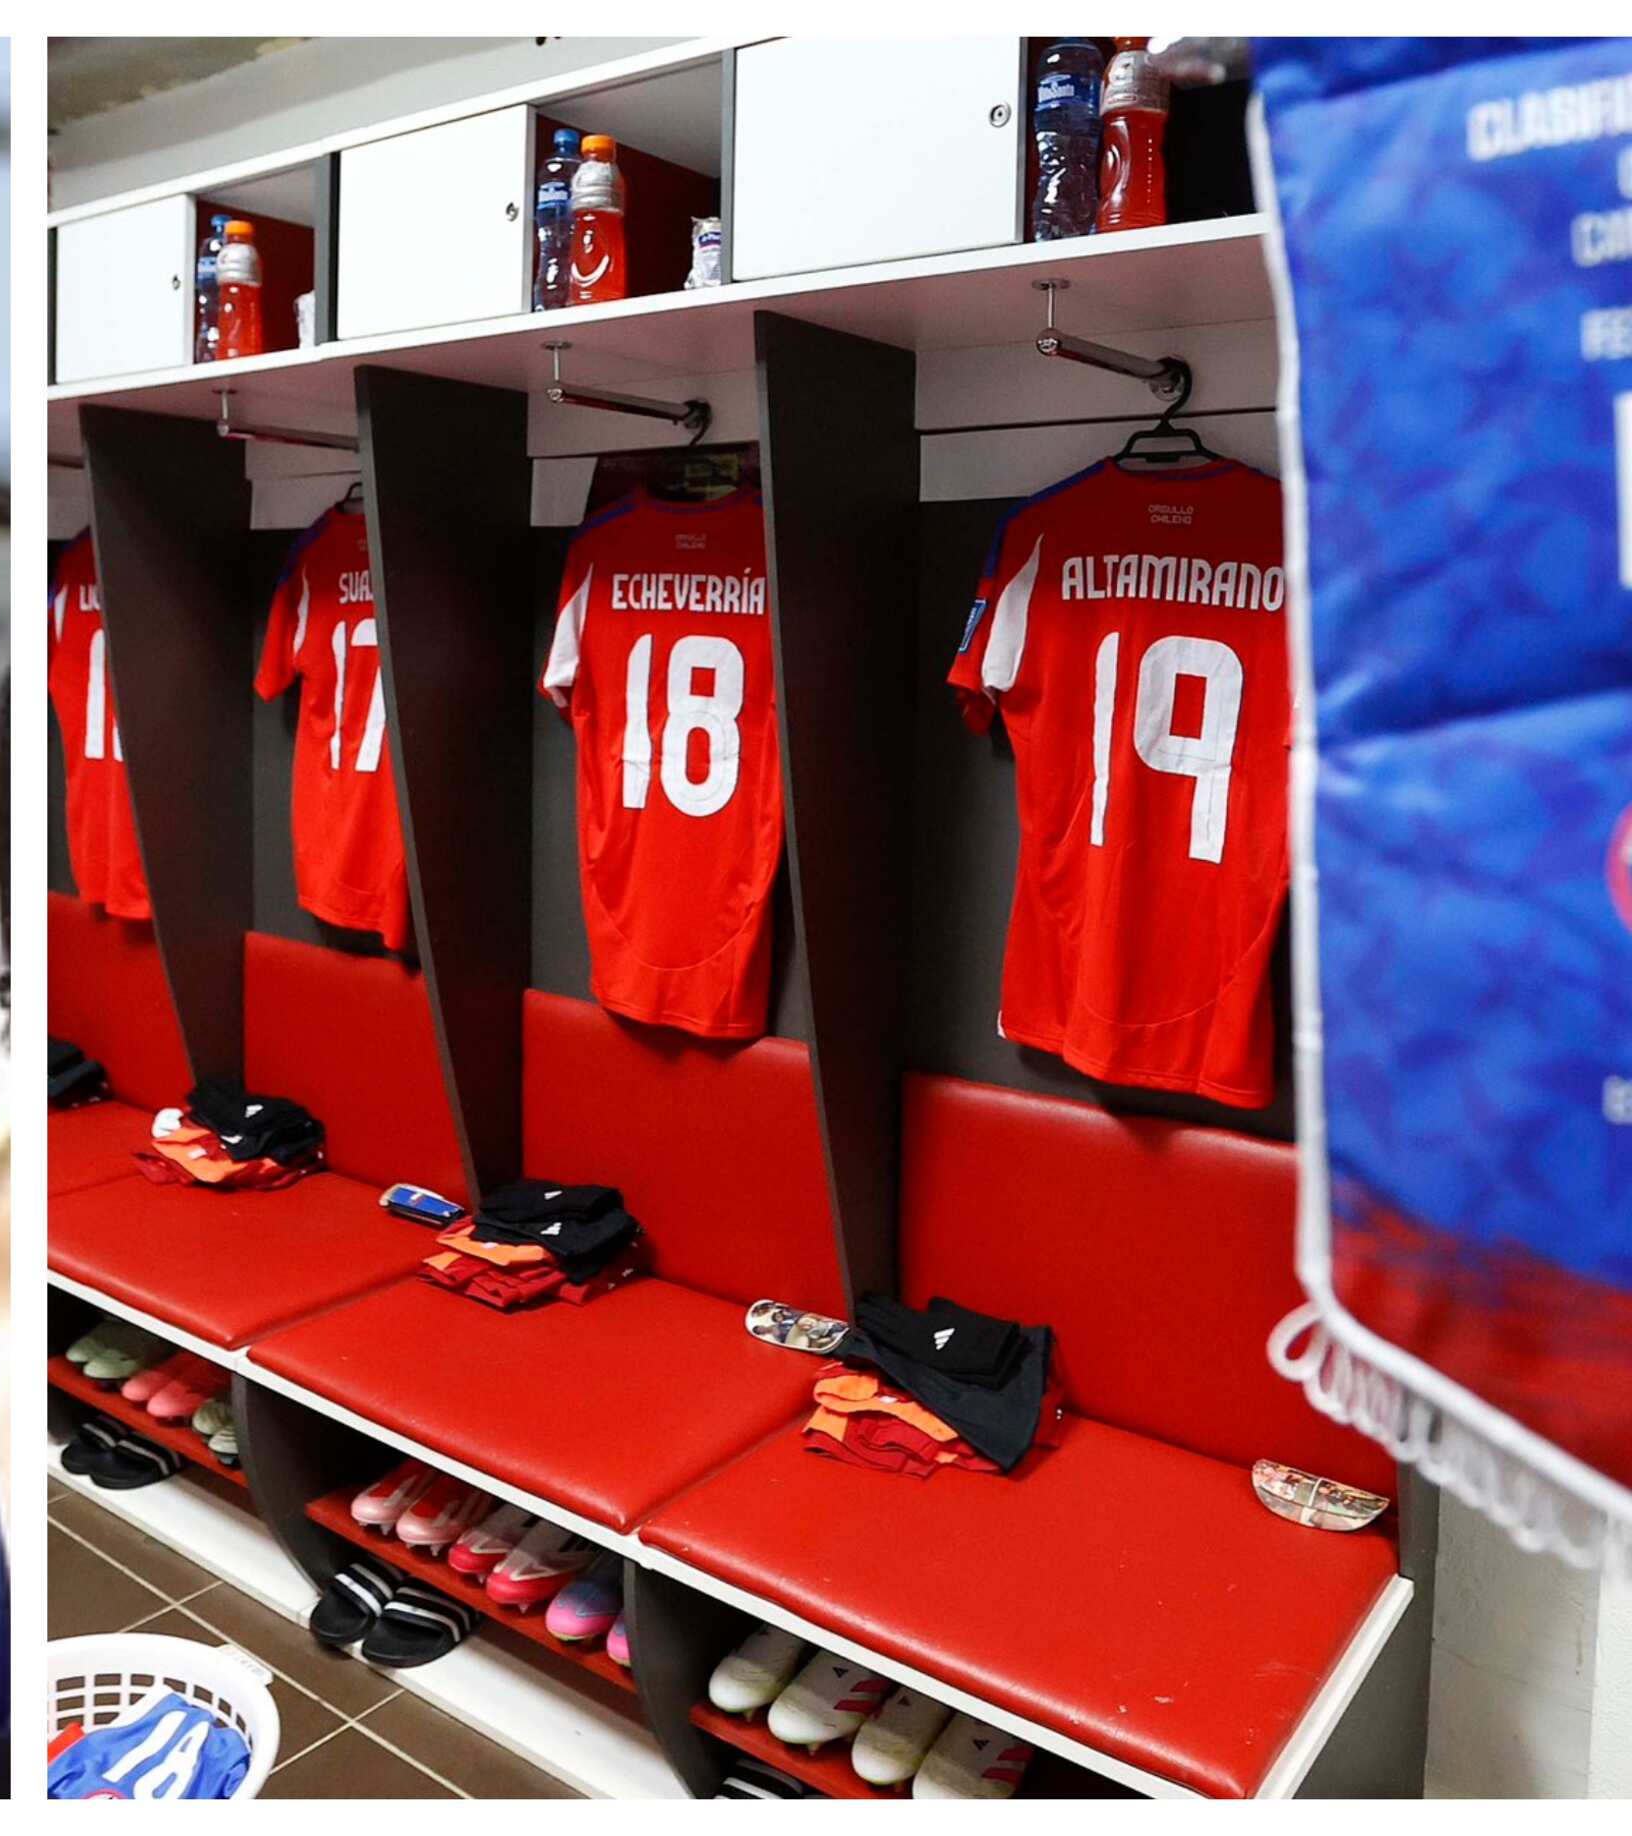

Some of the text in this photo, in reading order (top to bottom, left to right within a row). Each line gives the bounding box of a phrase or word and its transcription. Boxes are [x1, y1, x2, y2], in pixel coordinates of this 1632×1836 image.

[339, 569, 373, 604] SUA
[612, 567, 765, 615] ECHEVERRÍA
[1062, 554, 1286, 612] ALTAMIRANO
[622, 633, 744, 817] 18
[1090, 631, 1244, 864] 19
